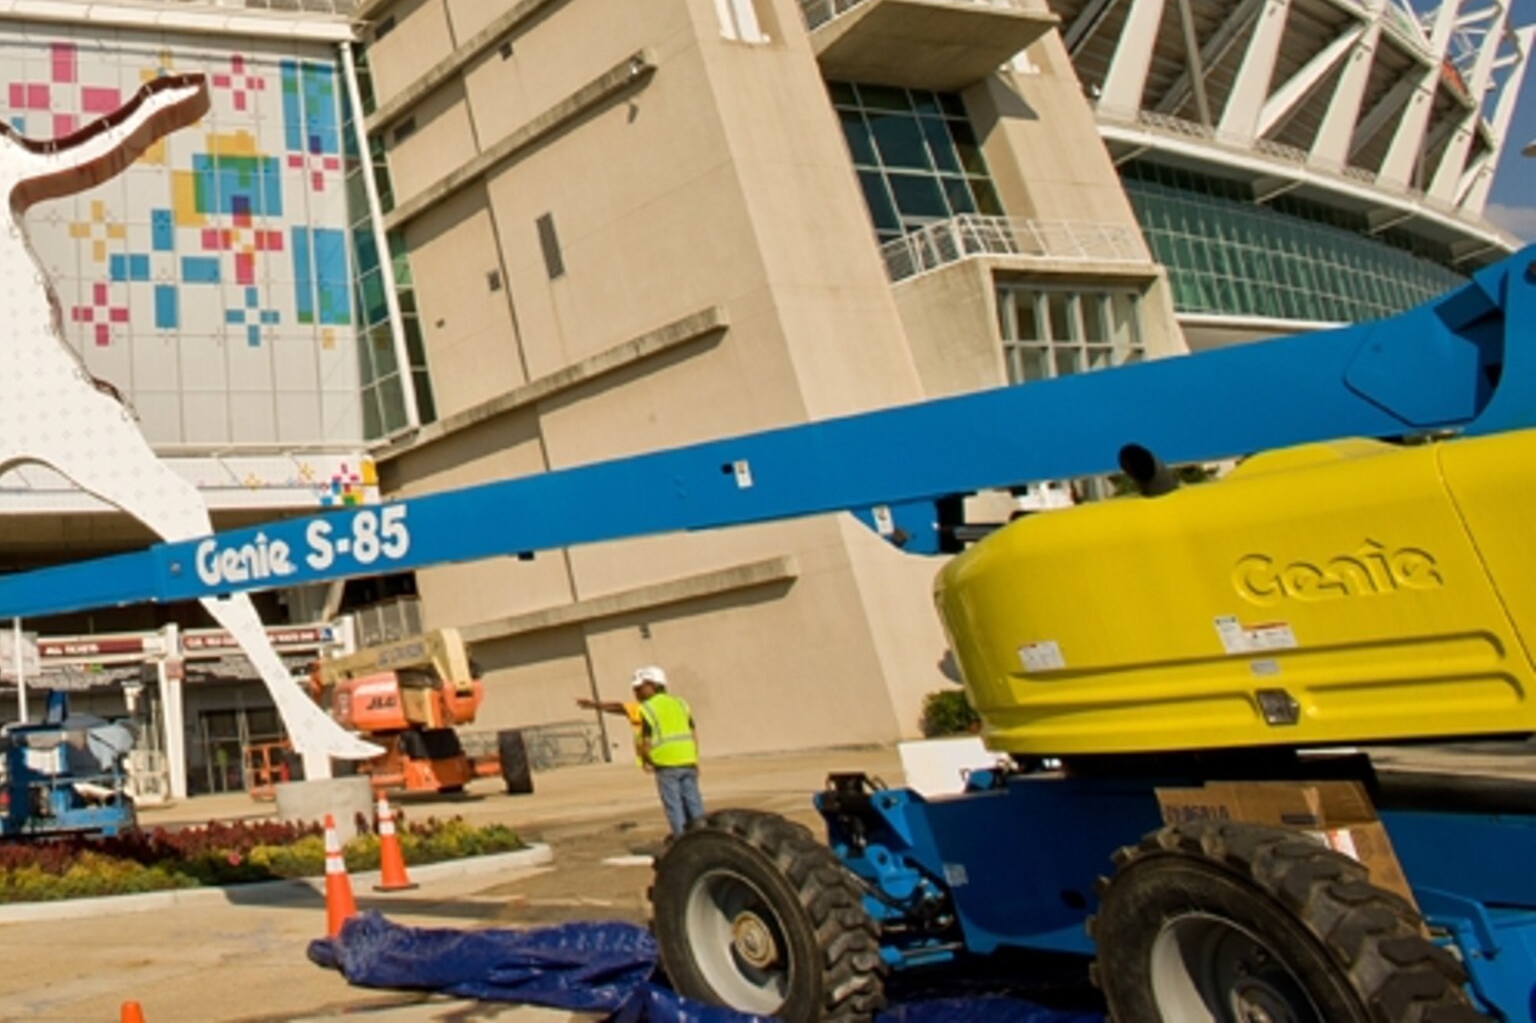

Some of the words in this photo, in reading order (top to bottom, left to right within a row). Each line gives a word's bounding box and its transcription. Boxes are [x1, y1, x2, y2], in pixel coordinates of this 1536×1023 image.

[196, 532, 297, 585] Genie
[305, 504, 411, 571] S-85
[1231, 537, 1445, 608] Genie
